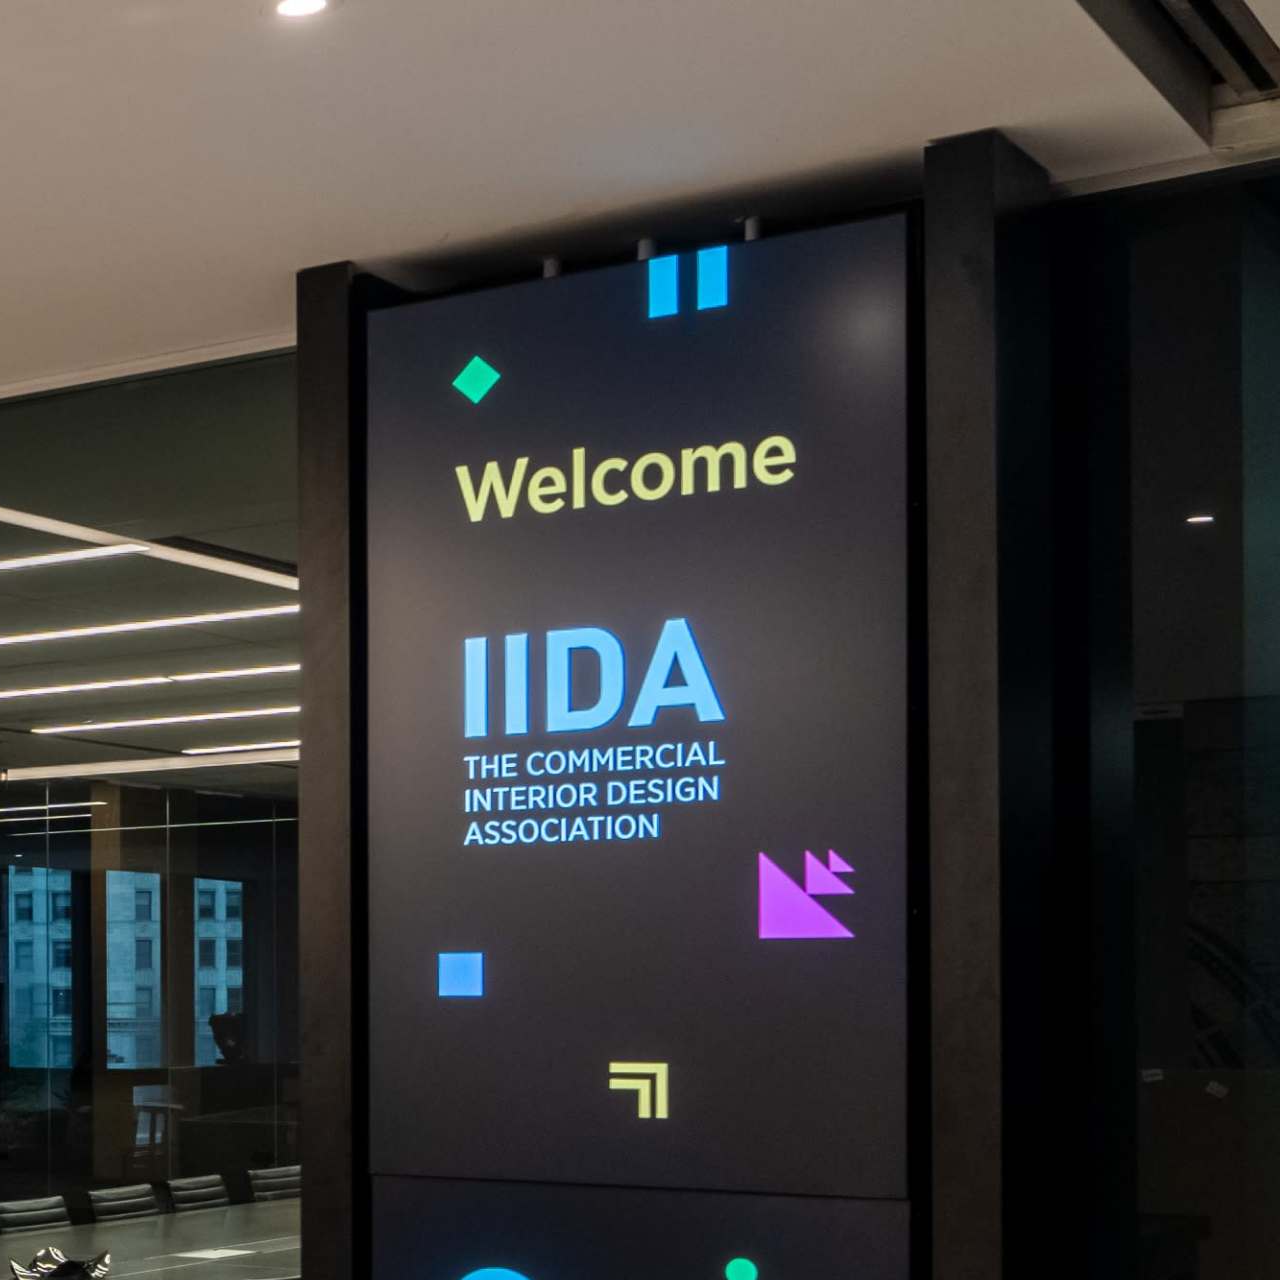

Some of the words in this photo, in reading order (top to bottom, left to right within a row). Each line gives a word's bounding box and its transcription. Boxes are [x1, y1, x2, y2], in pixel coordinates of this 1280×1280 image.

[454, 434, 797, 523] Welcome
[462, 616, 727, 739] IIDA
[462, 753, 519, 780] THE
[526, 739, 726, 777] COMMERCIAL
[463, 782, 598, 814] INTERIOR
[606, 774, 720, 806] DESIGN
[462, 812, 660, 847] ASSOCIATION
